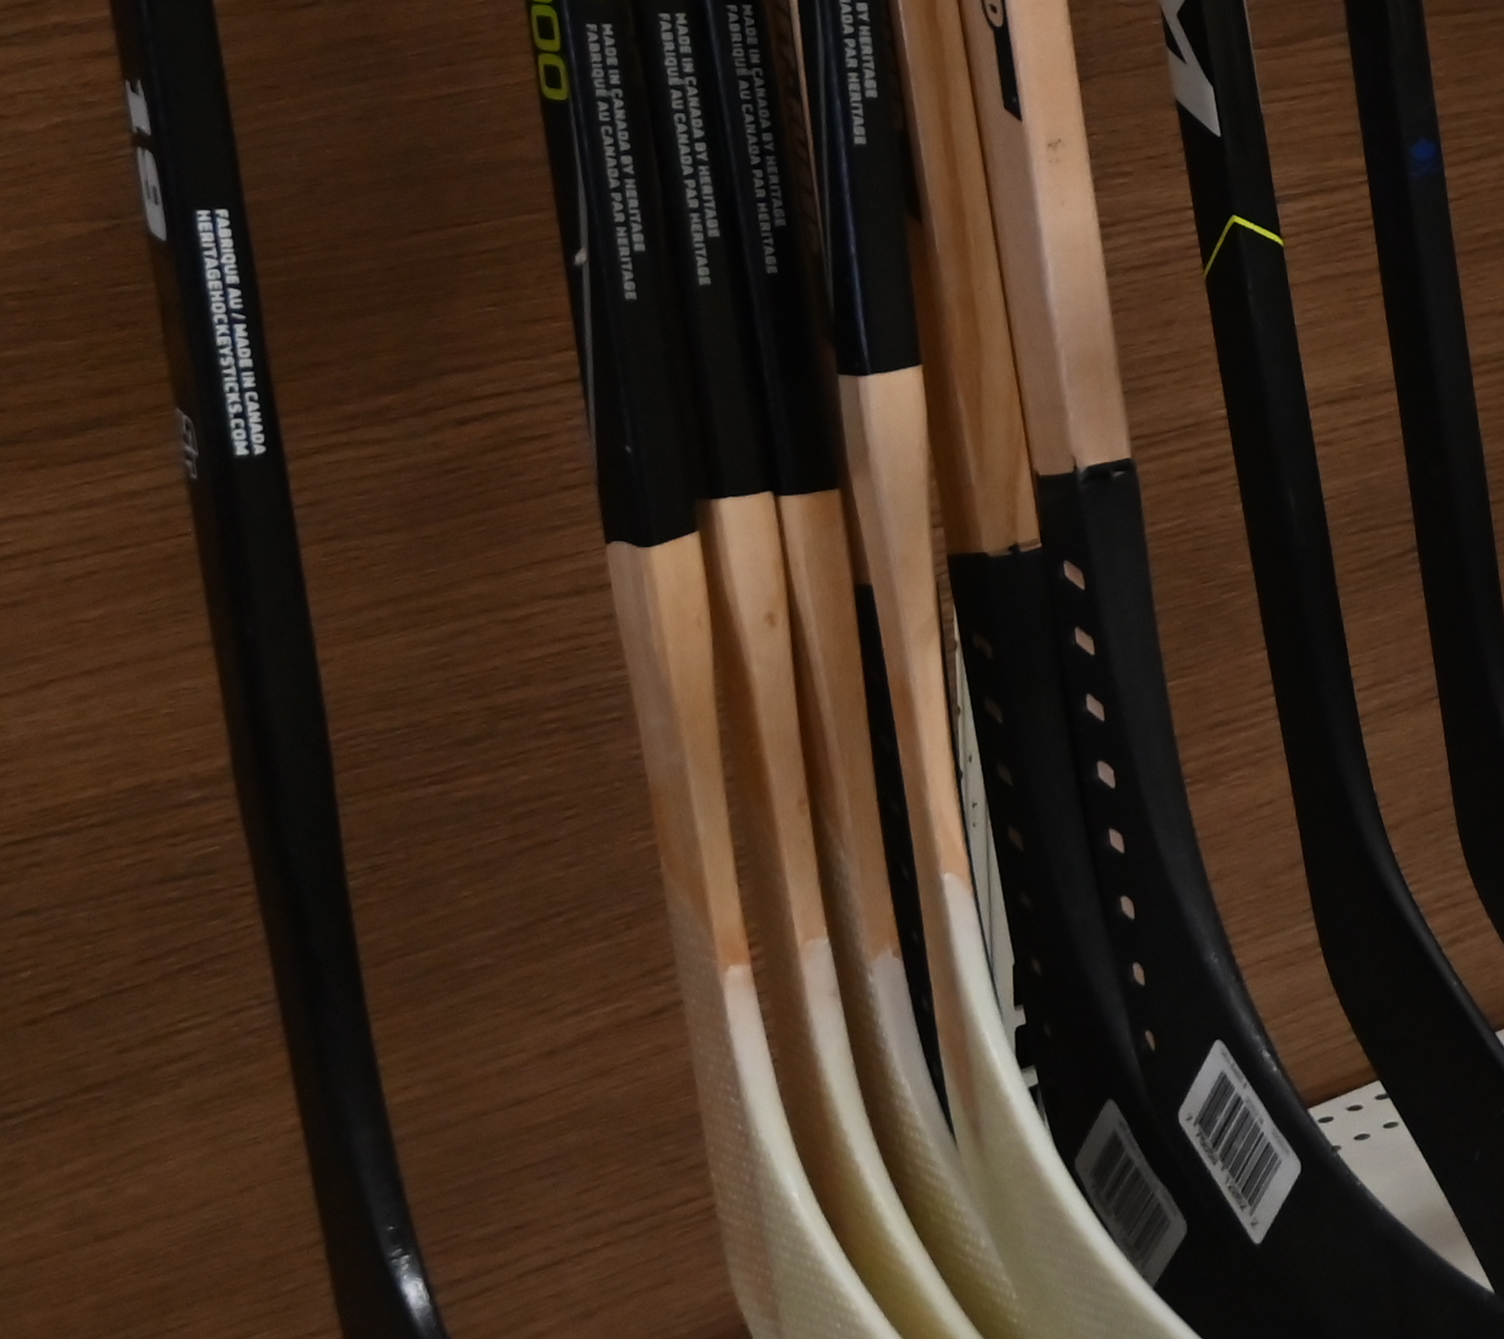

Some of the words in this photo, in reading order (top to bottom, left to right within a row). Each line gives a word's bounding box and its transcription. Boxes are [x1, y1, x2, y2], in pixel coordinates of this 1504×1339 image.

[215, 209, 240, 292] FABRIQUE
[228, 295, 242, 314] AU
[196, 210, 249, 456] HERITAGEHOCKEYSTICKS.COM
[233, 323, 253, 368] MADE
[240, 371, 255, 389] IN
[245, 391, 266, 455] CANADA
